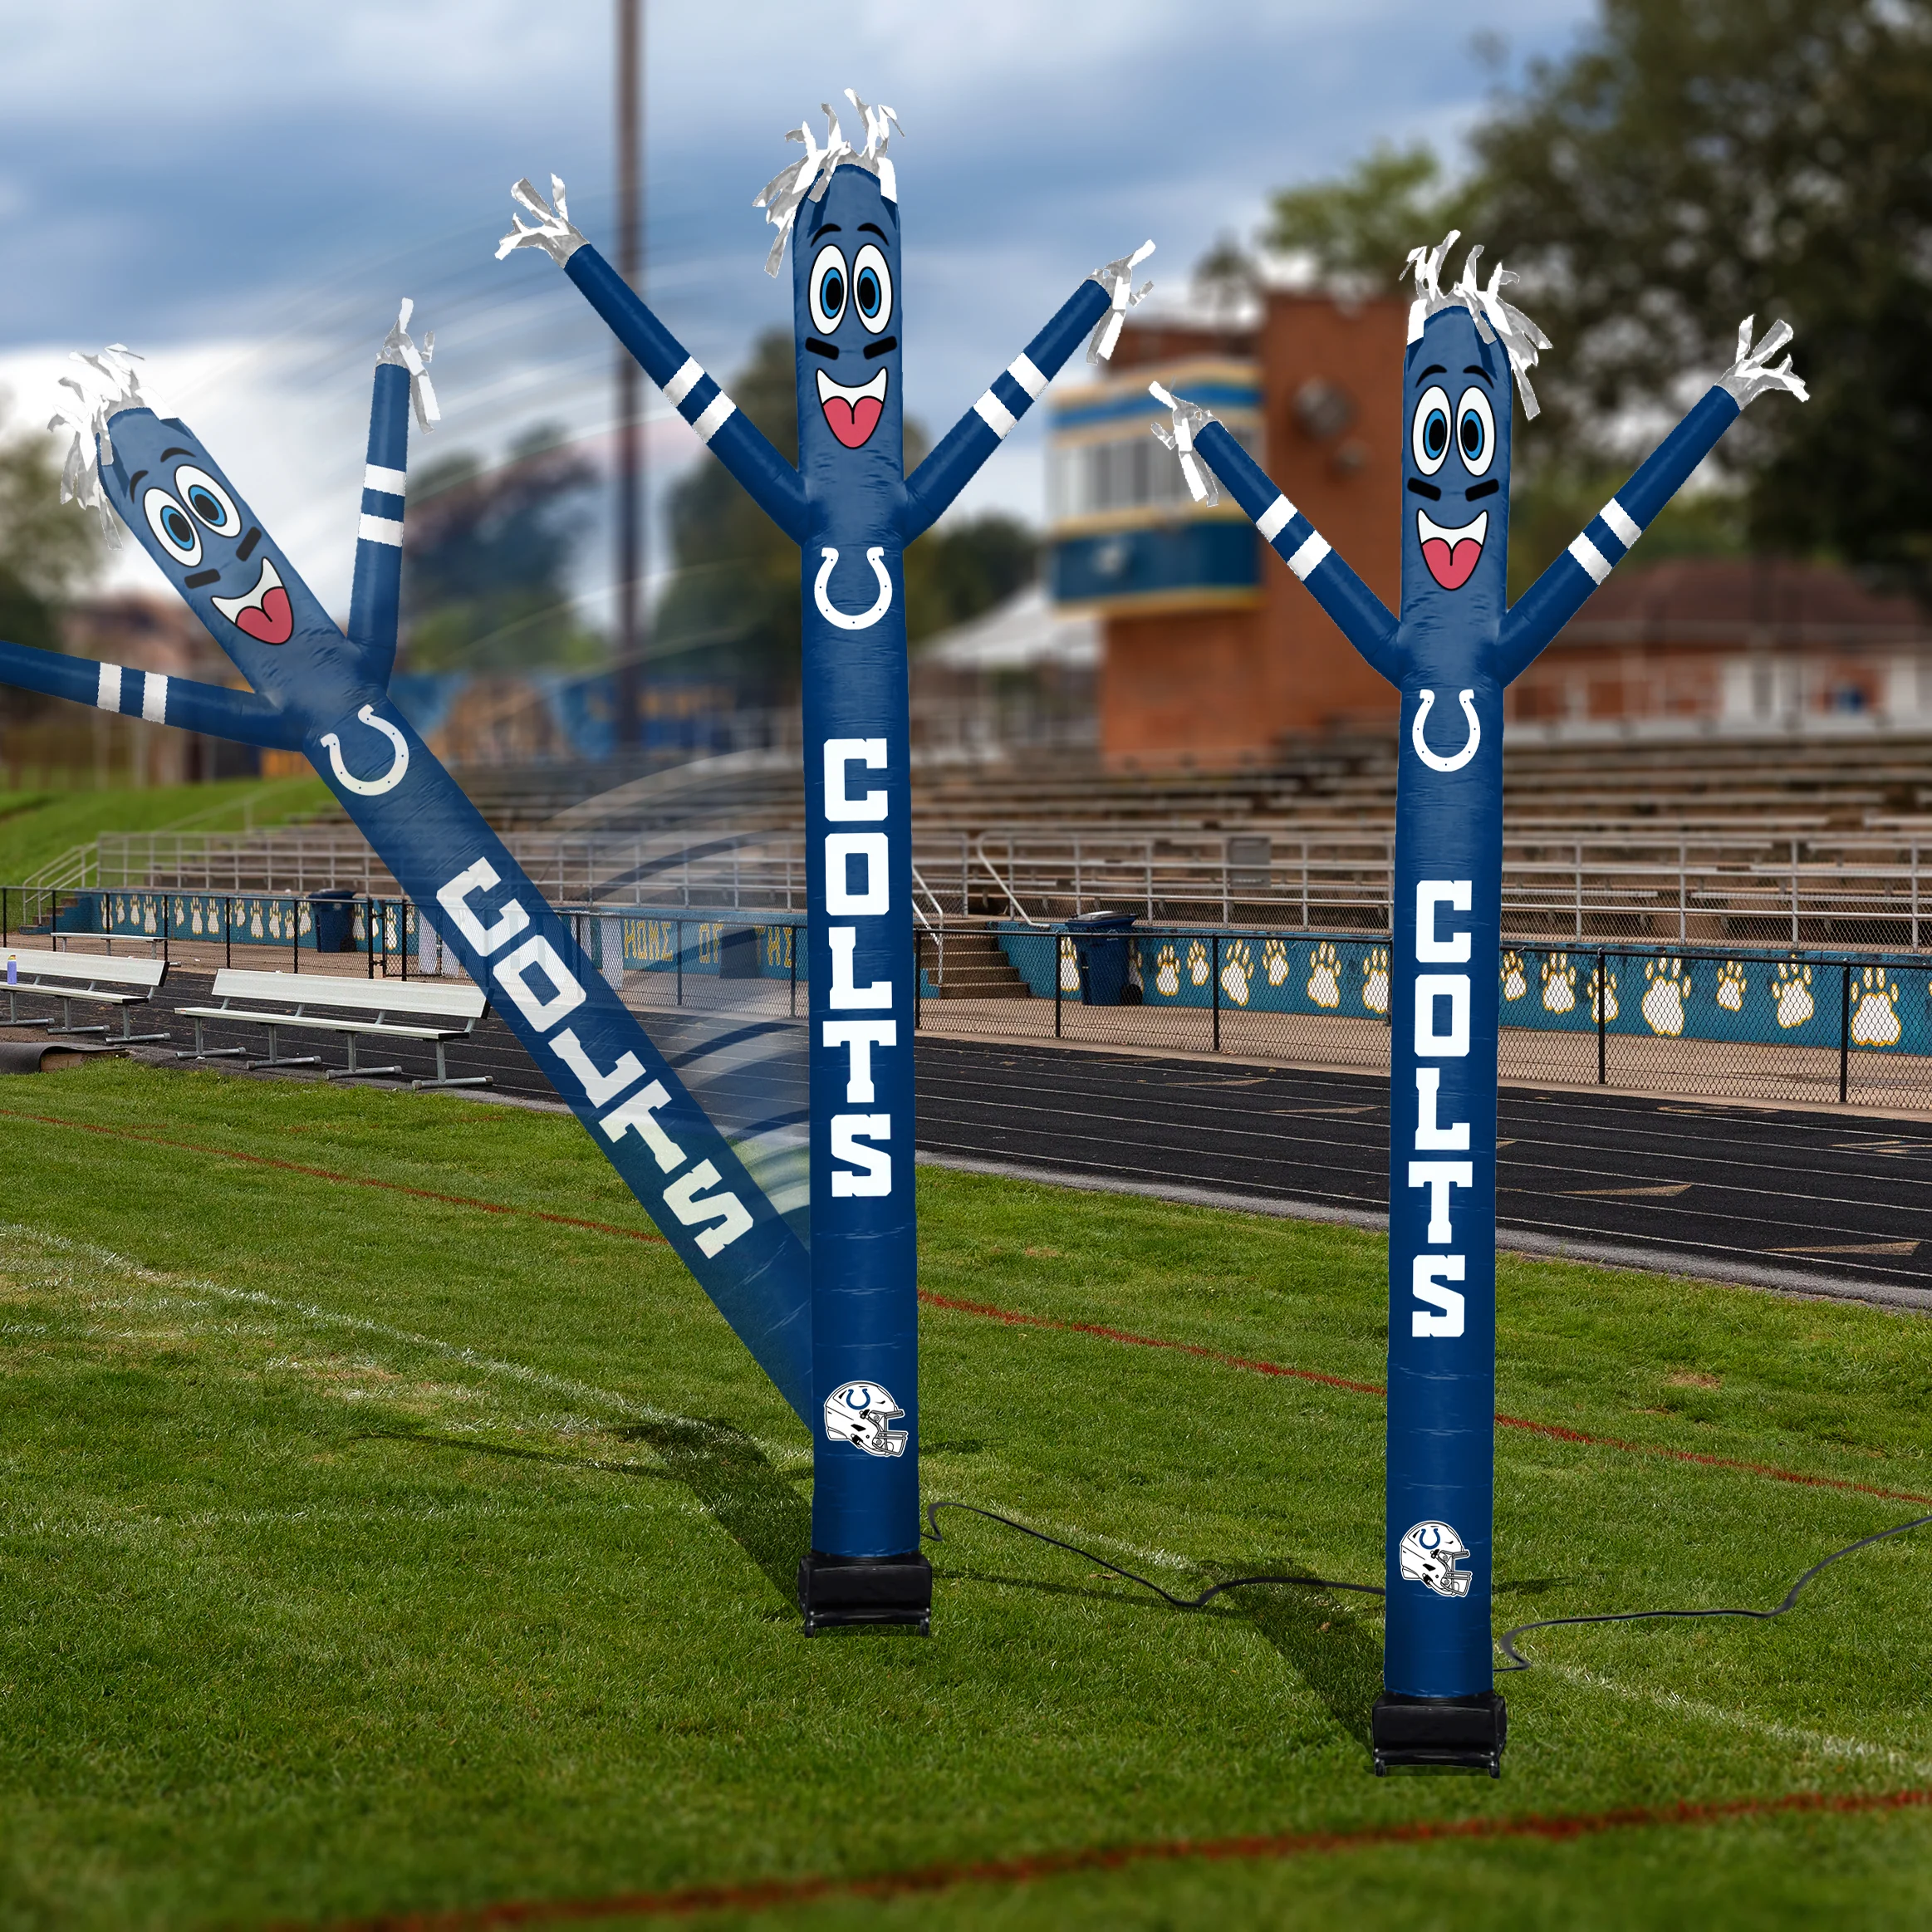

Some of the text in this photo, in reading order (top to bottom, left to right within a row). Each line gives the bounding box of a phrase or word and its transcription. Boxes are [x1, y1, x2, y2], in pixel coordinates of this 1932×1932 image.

[436, 856, 753, 1259] COLTS
[624, 919, 673, 961] HOME
[699, 923, 723, 964] OF
[824, 738, 897, 1197] COLTS
[1408, 880, 1473, 1337] COLTS
